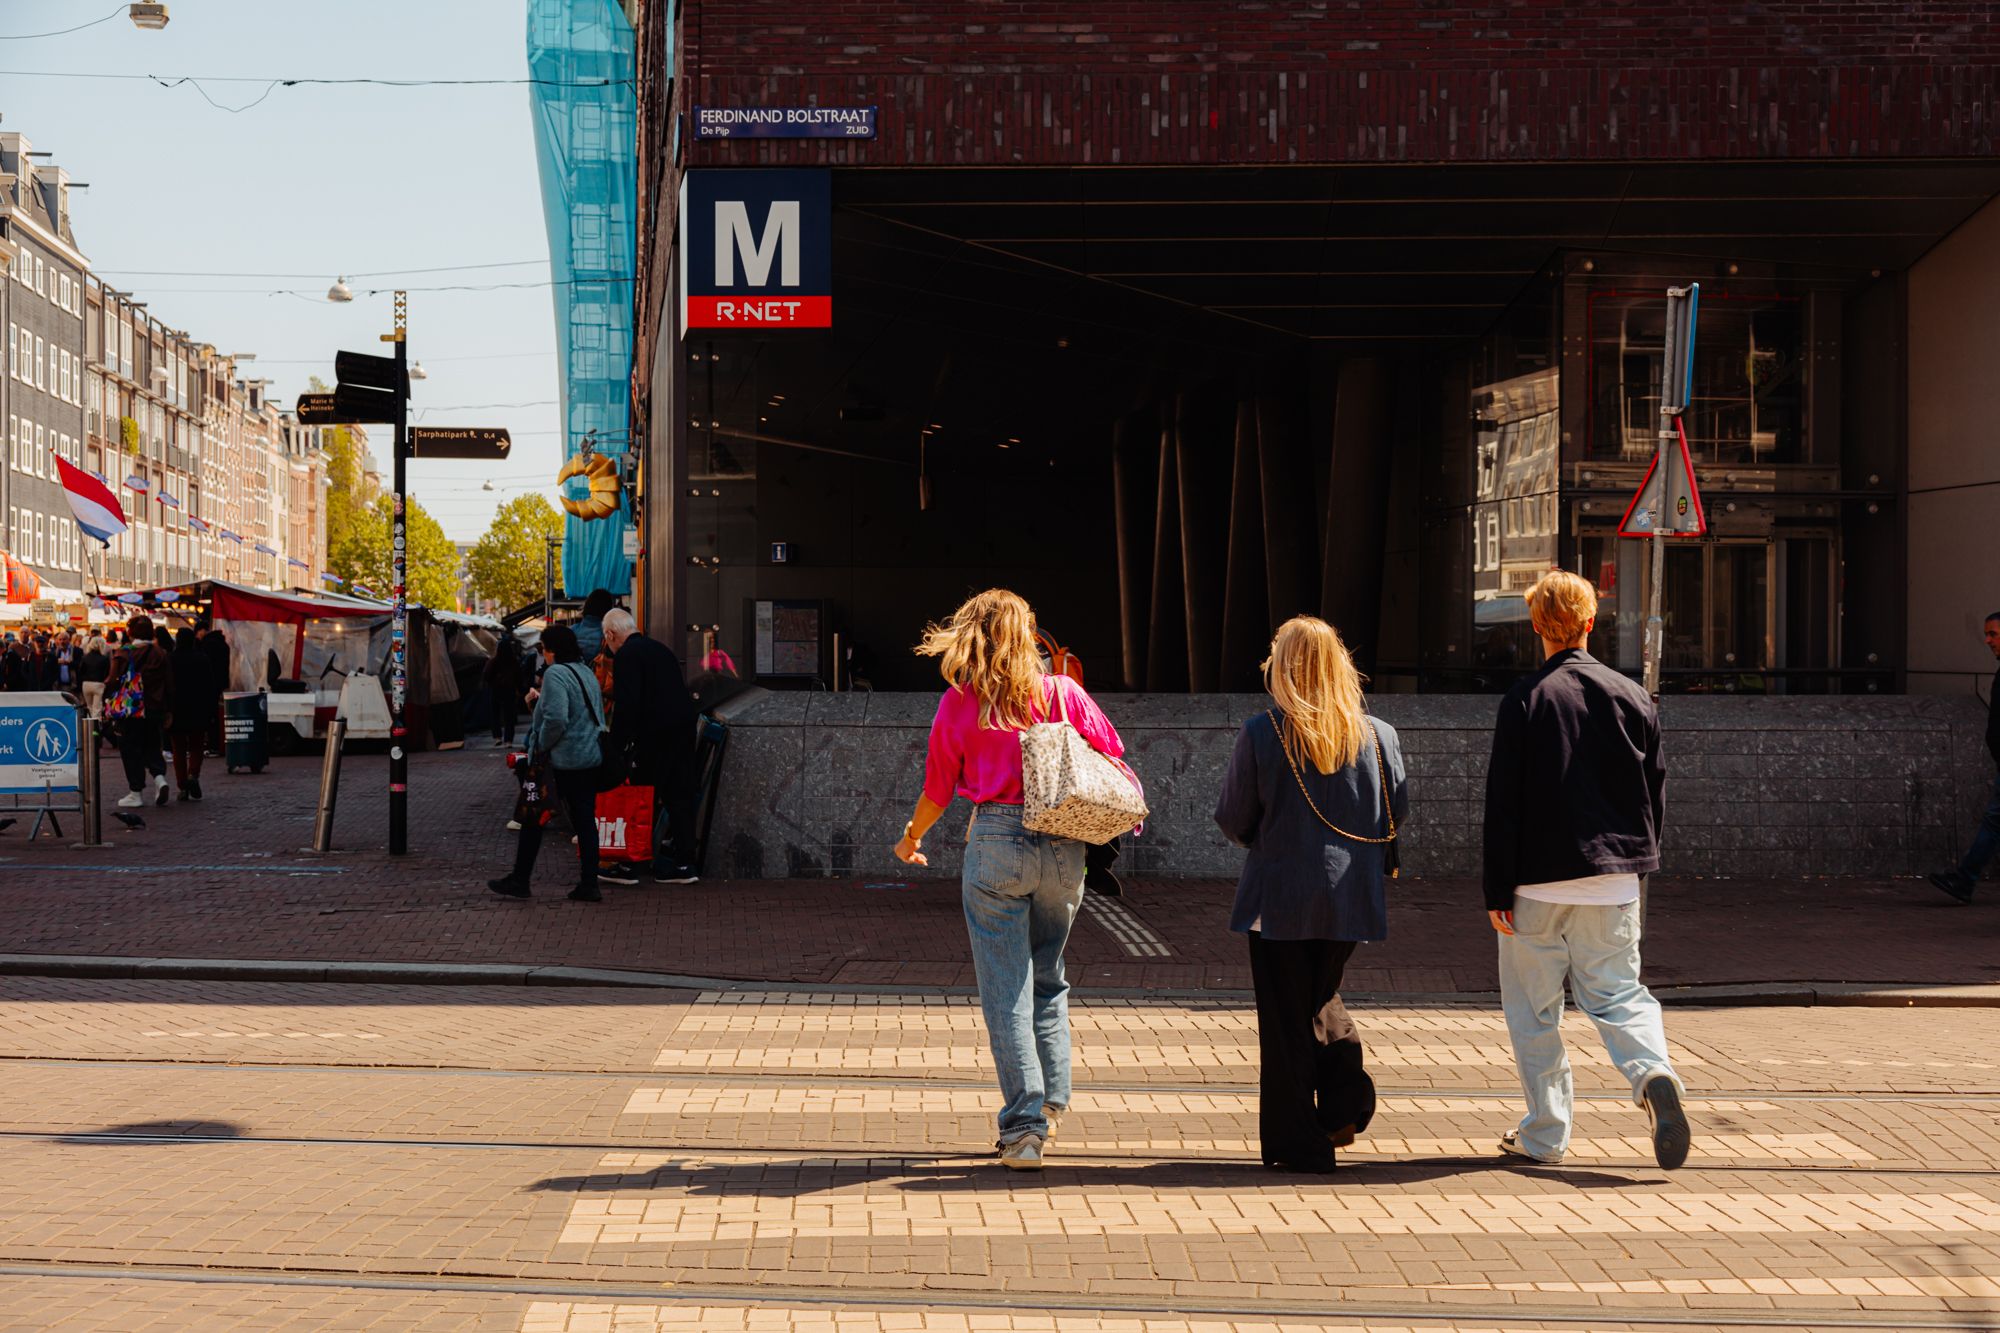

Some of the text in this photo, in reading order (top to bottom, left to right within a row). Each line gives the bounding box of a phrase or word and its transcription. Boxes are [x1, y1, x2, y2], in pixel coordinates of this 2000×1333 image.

[701, 109, 869, 123] FERDINAND BOLSTRAAT
[701, 126, 730, 136] De Pijp
[846, 126, 869, 134] ZUID
[715, 201, 800, 286] M
[417, 430, 496, 440] Sarphatipark 0,4
[594, 816, 628, 847] irk
